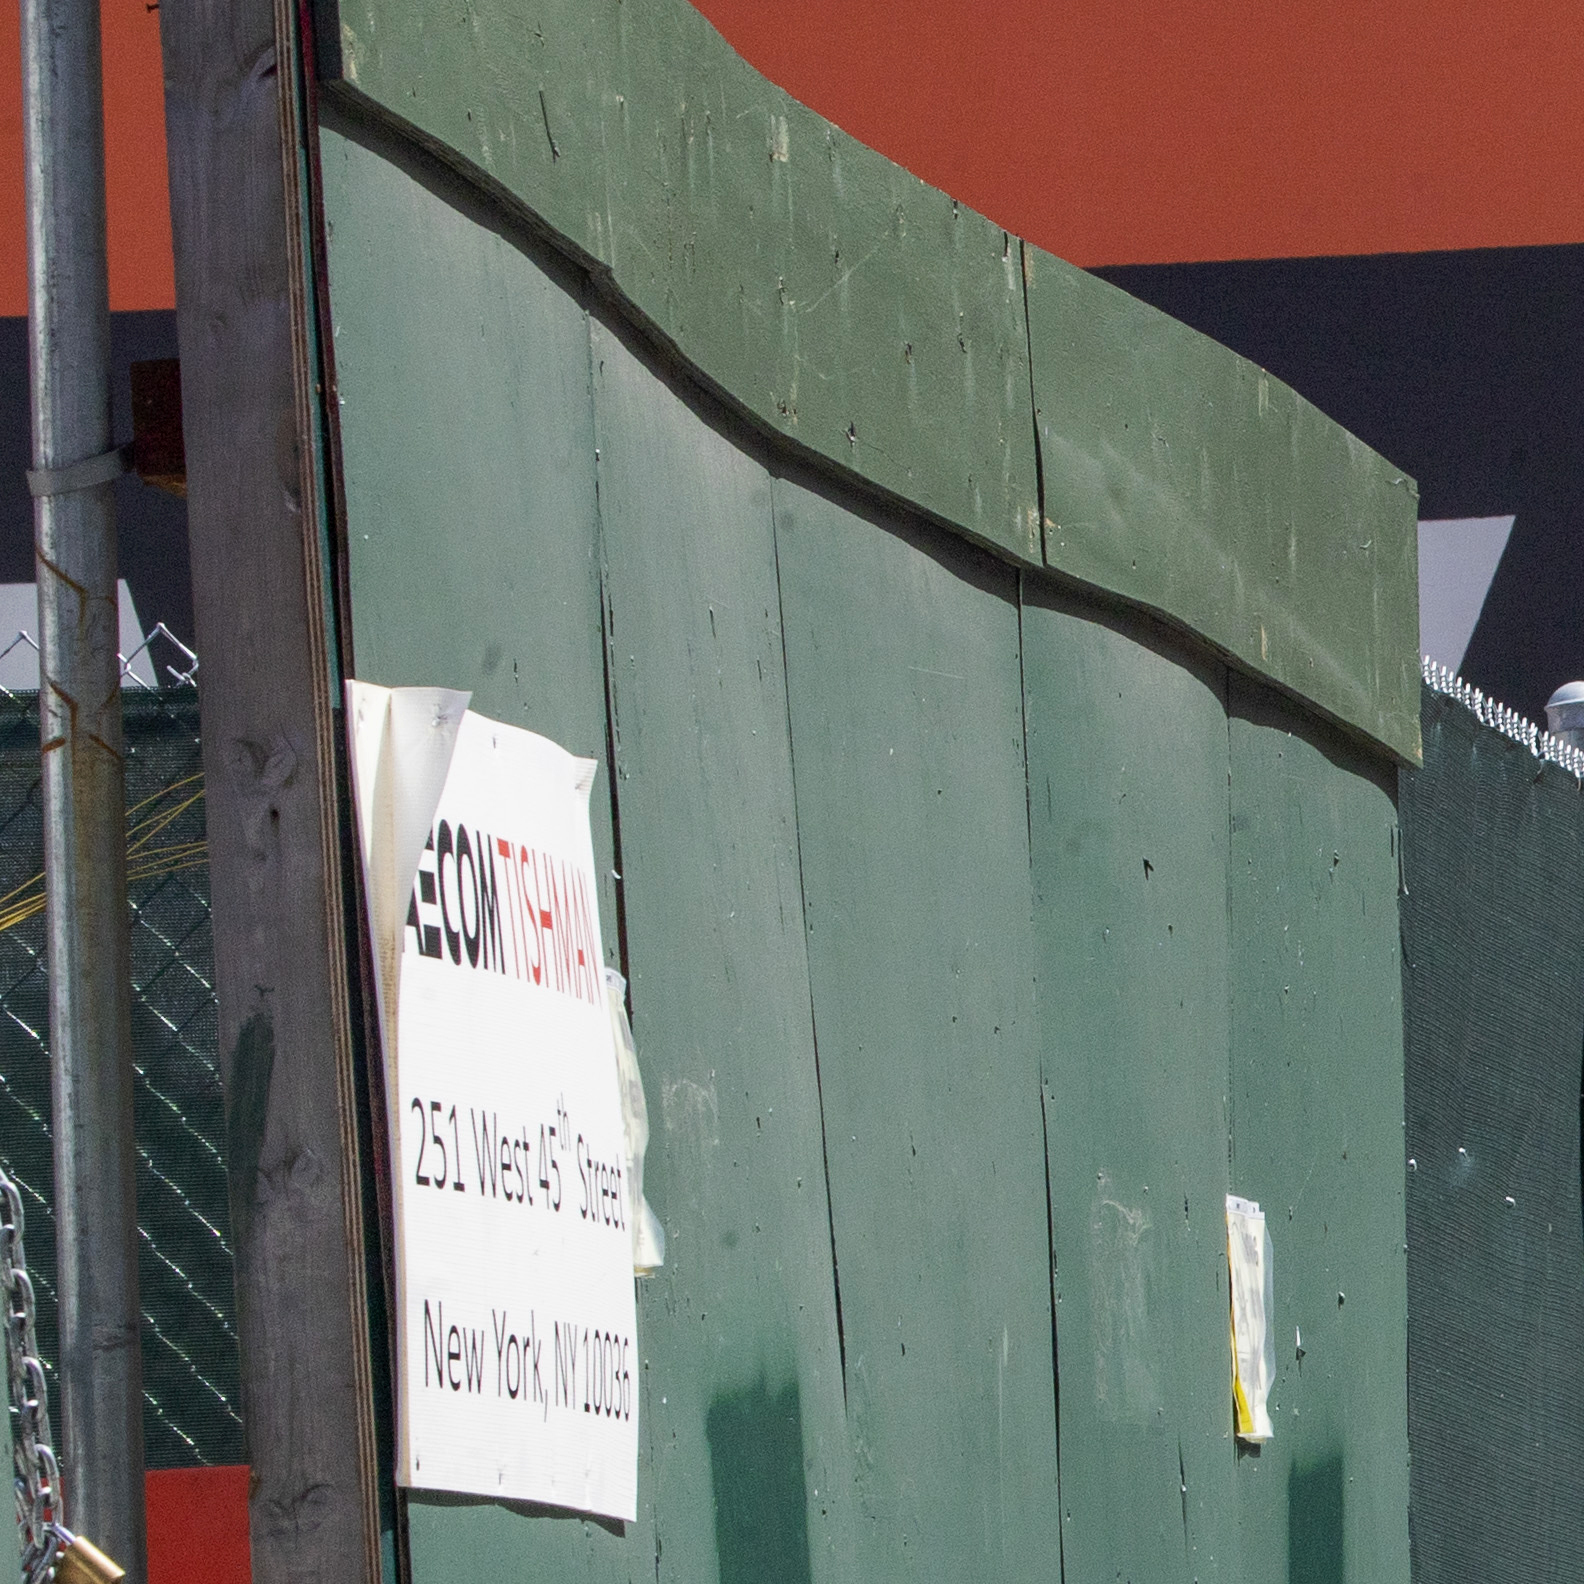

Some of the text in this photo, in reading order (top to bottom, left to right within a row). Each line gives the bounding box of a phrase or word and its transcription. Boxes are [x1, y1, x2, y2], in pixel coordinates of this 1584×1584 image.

[411, 1097, 465, 1193] 251
[470, 1107, 533, 1206] West
[577, 1133, 625, 1231] Street
[424, 1299, 631, 1423] New York, NY 10036
